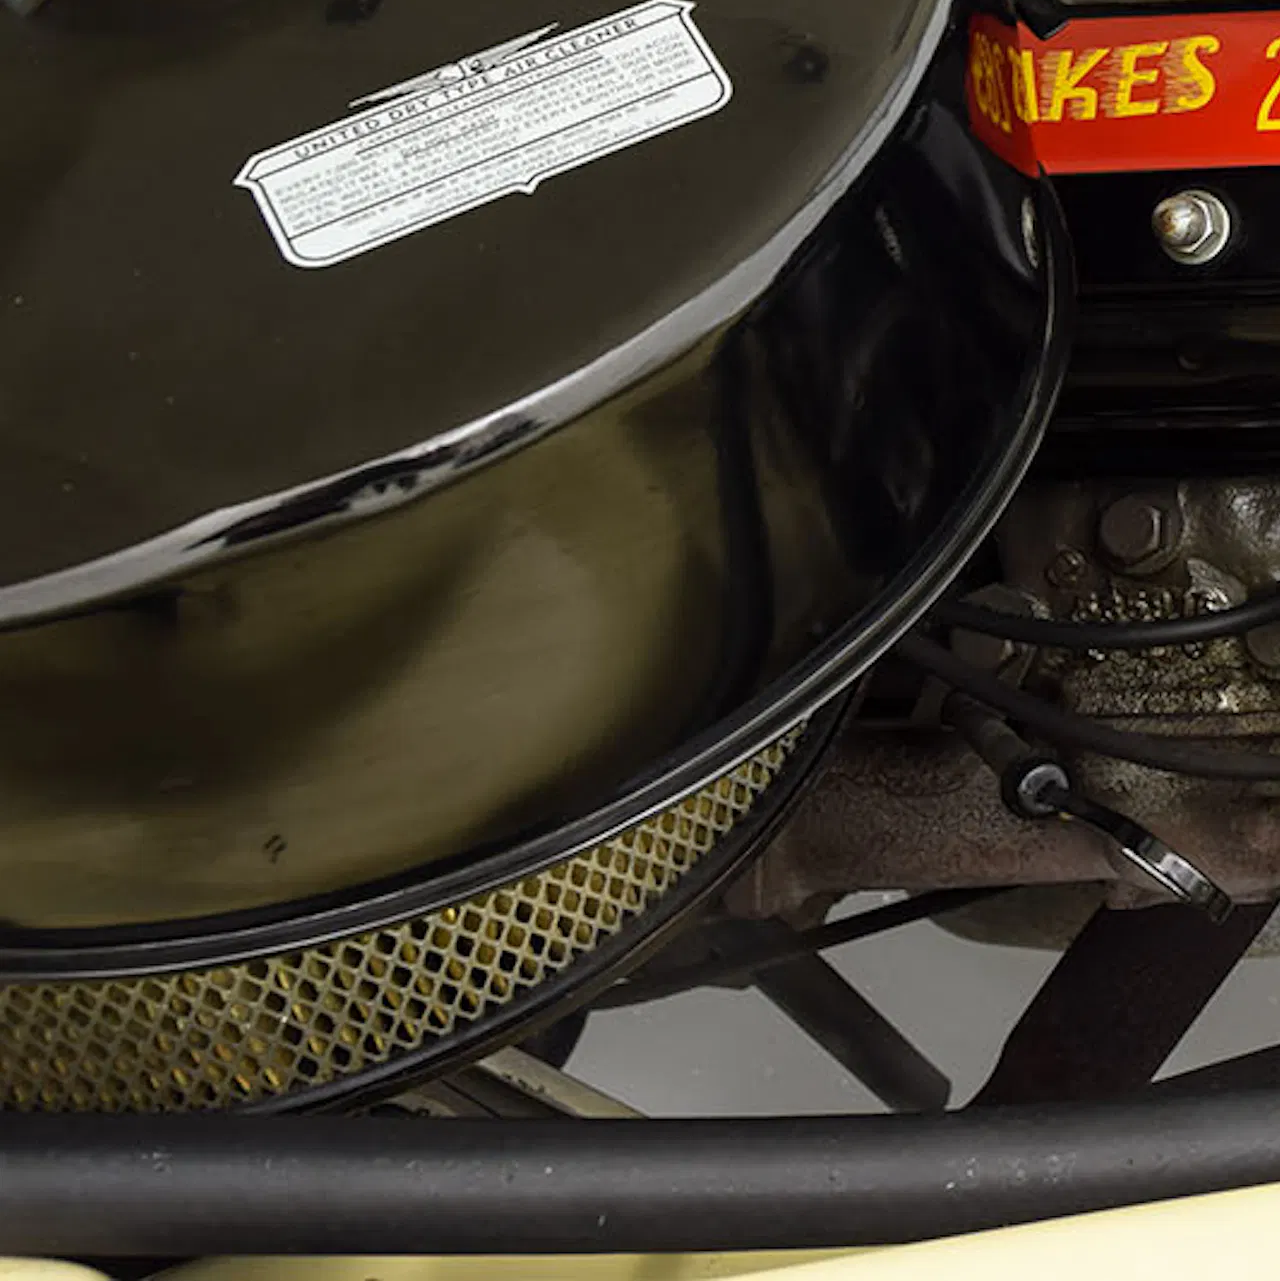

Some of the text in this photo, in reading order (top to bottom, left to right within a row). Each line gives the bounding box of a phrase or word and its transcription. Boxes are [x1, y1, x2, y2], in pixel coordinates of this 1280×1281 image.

[293, 117, 381, 159] UNITED
[388, 97, 431, 122] DRY
[439, 73, 493, 102] TYPE
[502, 56, 537, 78] AIR
[543, 17, 637, 61] CLEANER
